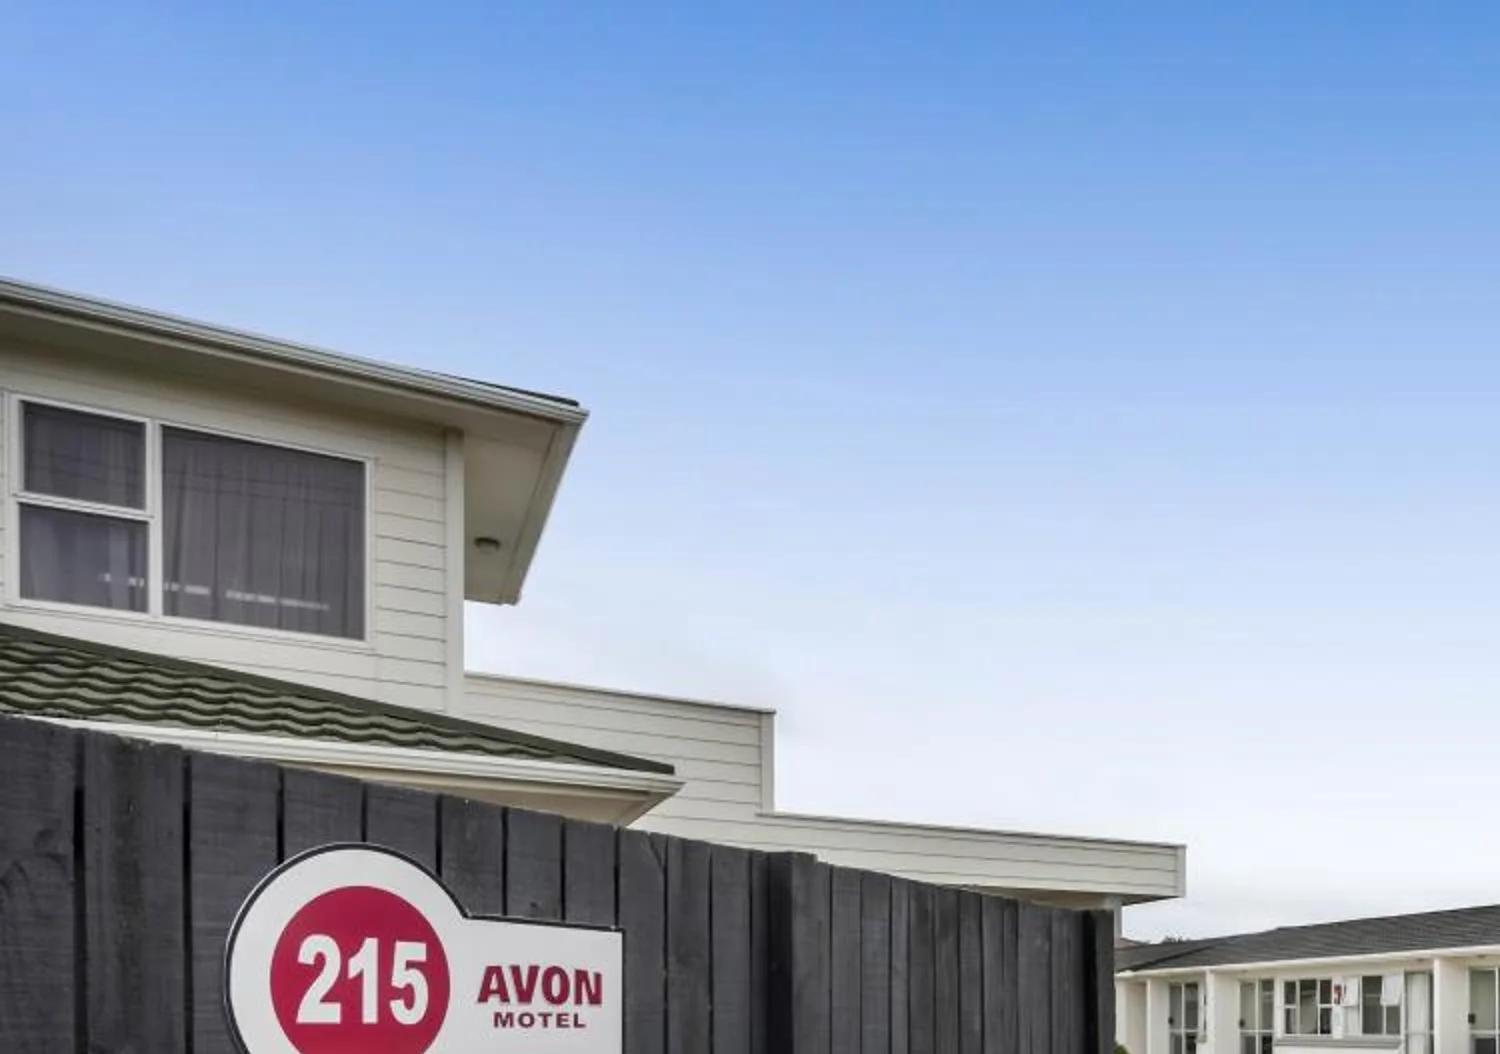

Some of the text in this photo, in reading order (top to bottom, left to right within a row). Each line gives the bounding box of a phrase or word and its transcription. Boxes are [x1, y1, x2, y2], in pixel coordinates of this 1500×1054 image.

[296, 933, 430, 1025] 215
[478, 964, 602, 1007] AVON
[494, 1011, 586, 1029] MOTEL
